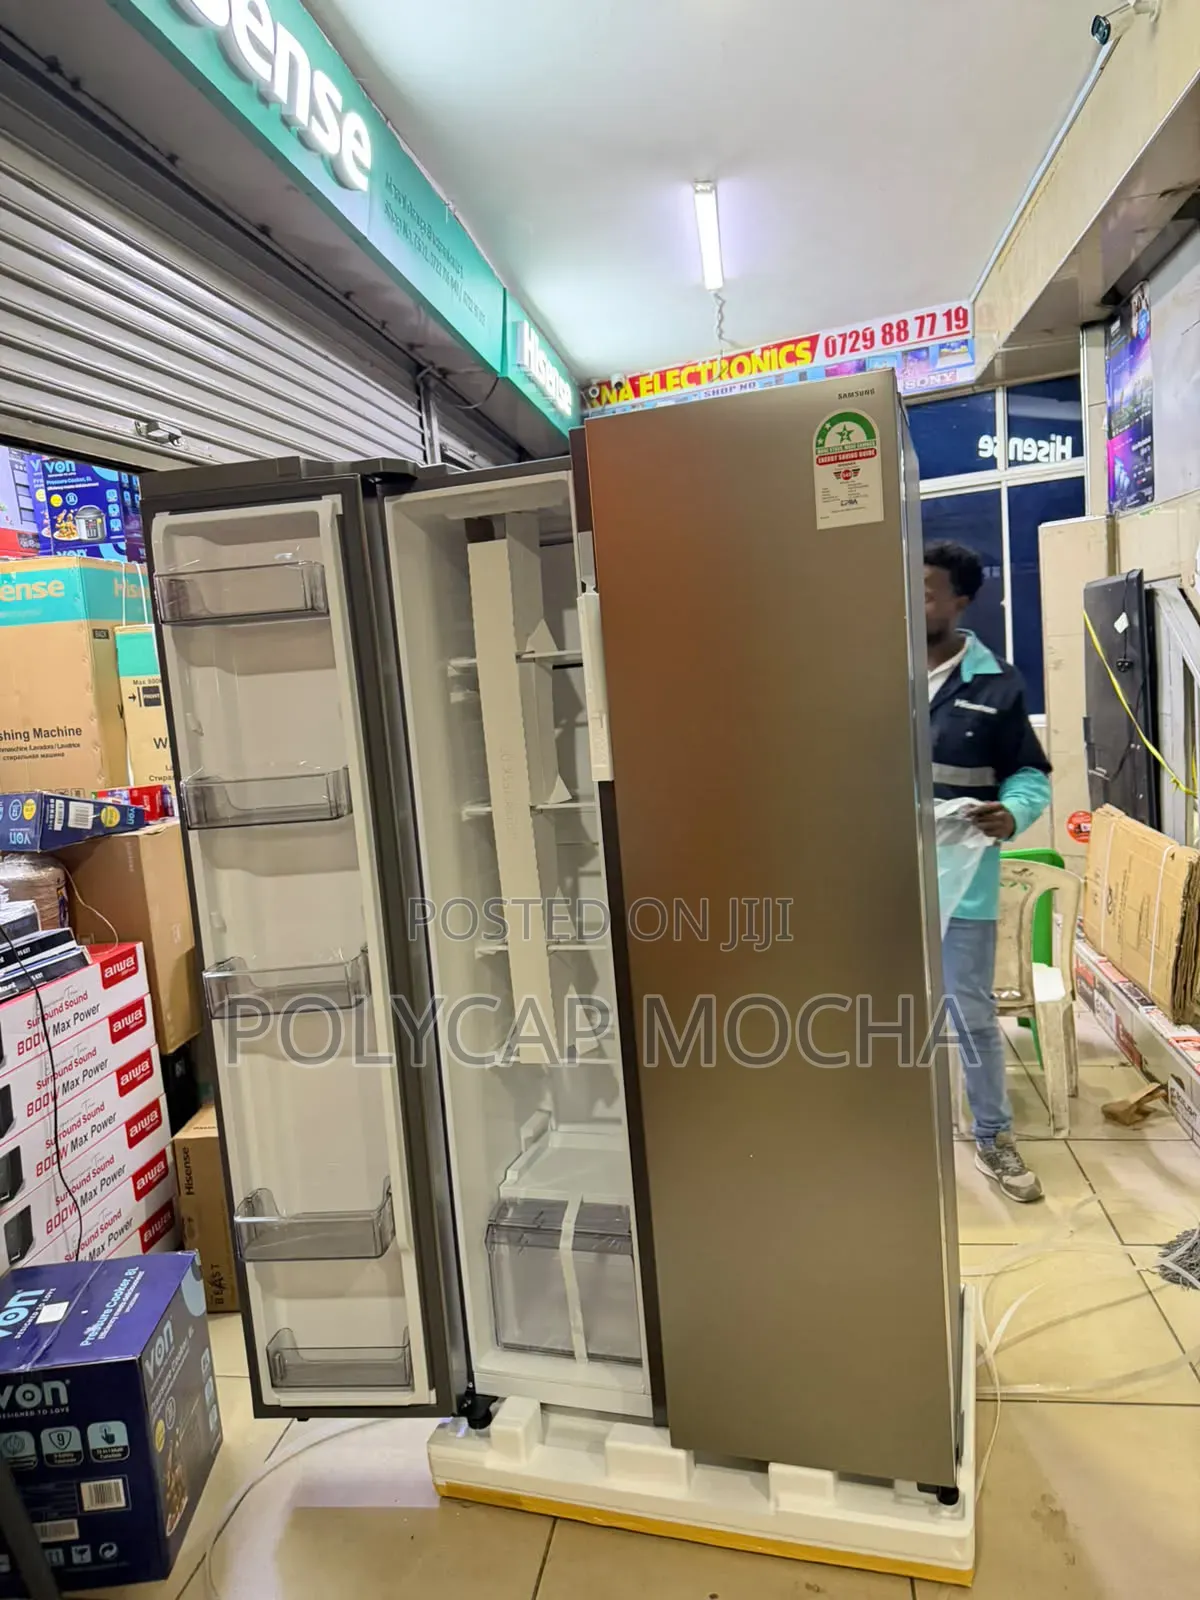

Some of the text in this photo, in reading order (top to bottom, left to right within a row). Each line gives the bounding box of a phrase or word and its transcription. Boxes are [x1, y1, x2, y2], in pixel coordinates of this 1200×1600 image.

[189, 0, 371, 192] ense
[590, 305, 969, 408] NA ELECTRONICS 0729 88 77 19
[837, 388, 875, 400] SAMSUNG
[903, 371, 953, 390] SONY
[33, 726, 82, 739] Machine
[104, 955, 136, 978] aiwa
[26, 1006, 64, 1030] Suround
[64, 990, 89, 1011] Sound
[52, 1018, 72, 1038] Max
[72, 1003, 101, 1026] Power
[112, 1007, 144, 1033] aiwa
[74, 1047, 97, 1068] Sound
[120, 1059, 151, 1086] aiwa
[61, 1077, 80, 1096] Max
[82, 1058, 109, 1082] Power
[45, 1101, 106, 1149] Suround Sound
[70, 1133, 89, 1153] Max
[90, 1112, 117, 1138] Power
[129, 1109, 159, 1138] aiwa
[55, 1155, 115, 1206] Suround Sound
[80, 1187, 99, 1208] Max
[100, 1164, 127, 1192] Power
[136, 1160, 166, 1191] aiwa
[183, 1147, 195, 1196] Hisense
[99, 1208, 123, 1233] Sound
[107, 1217, 134, 1246] Power
[57, 1433, 65, 1447] 9
